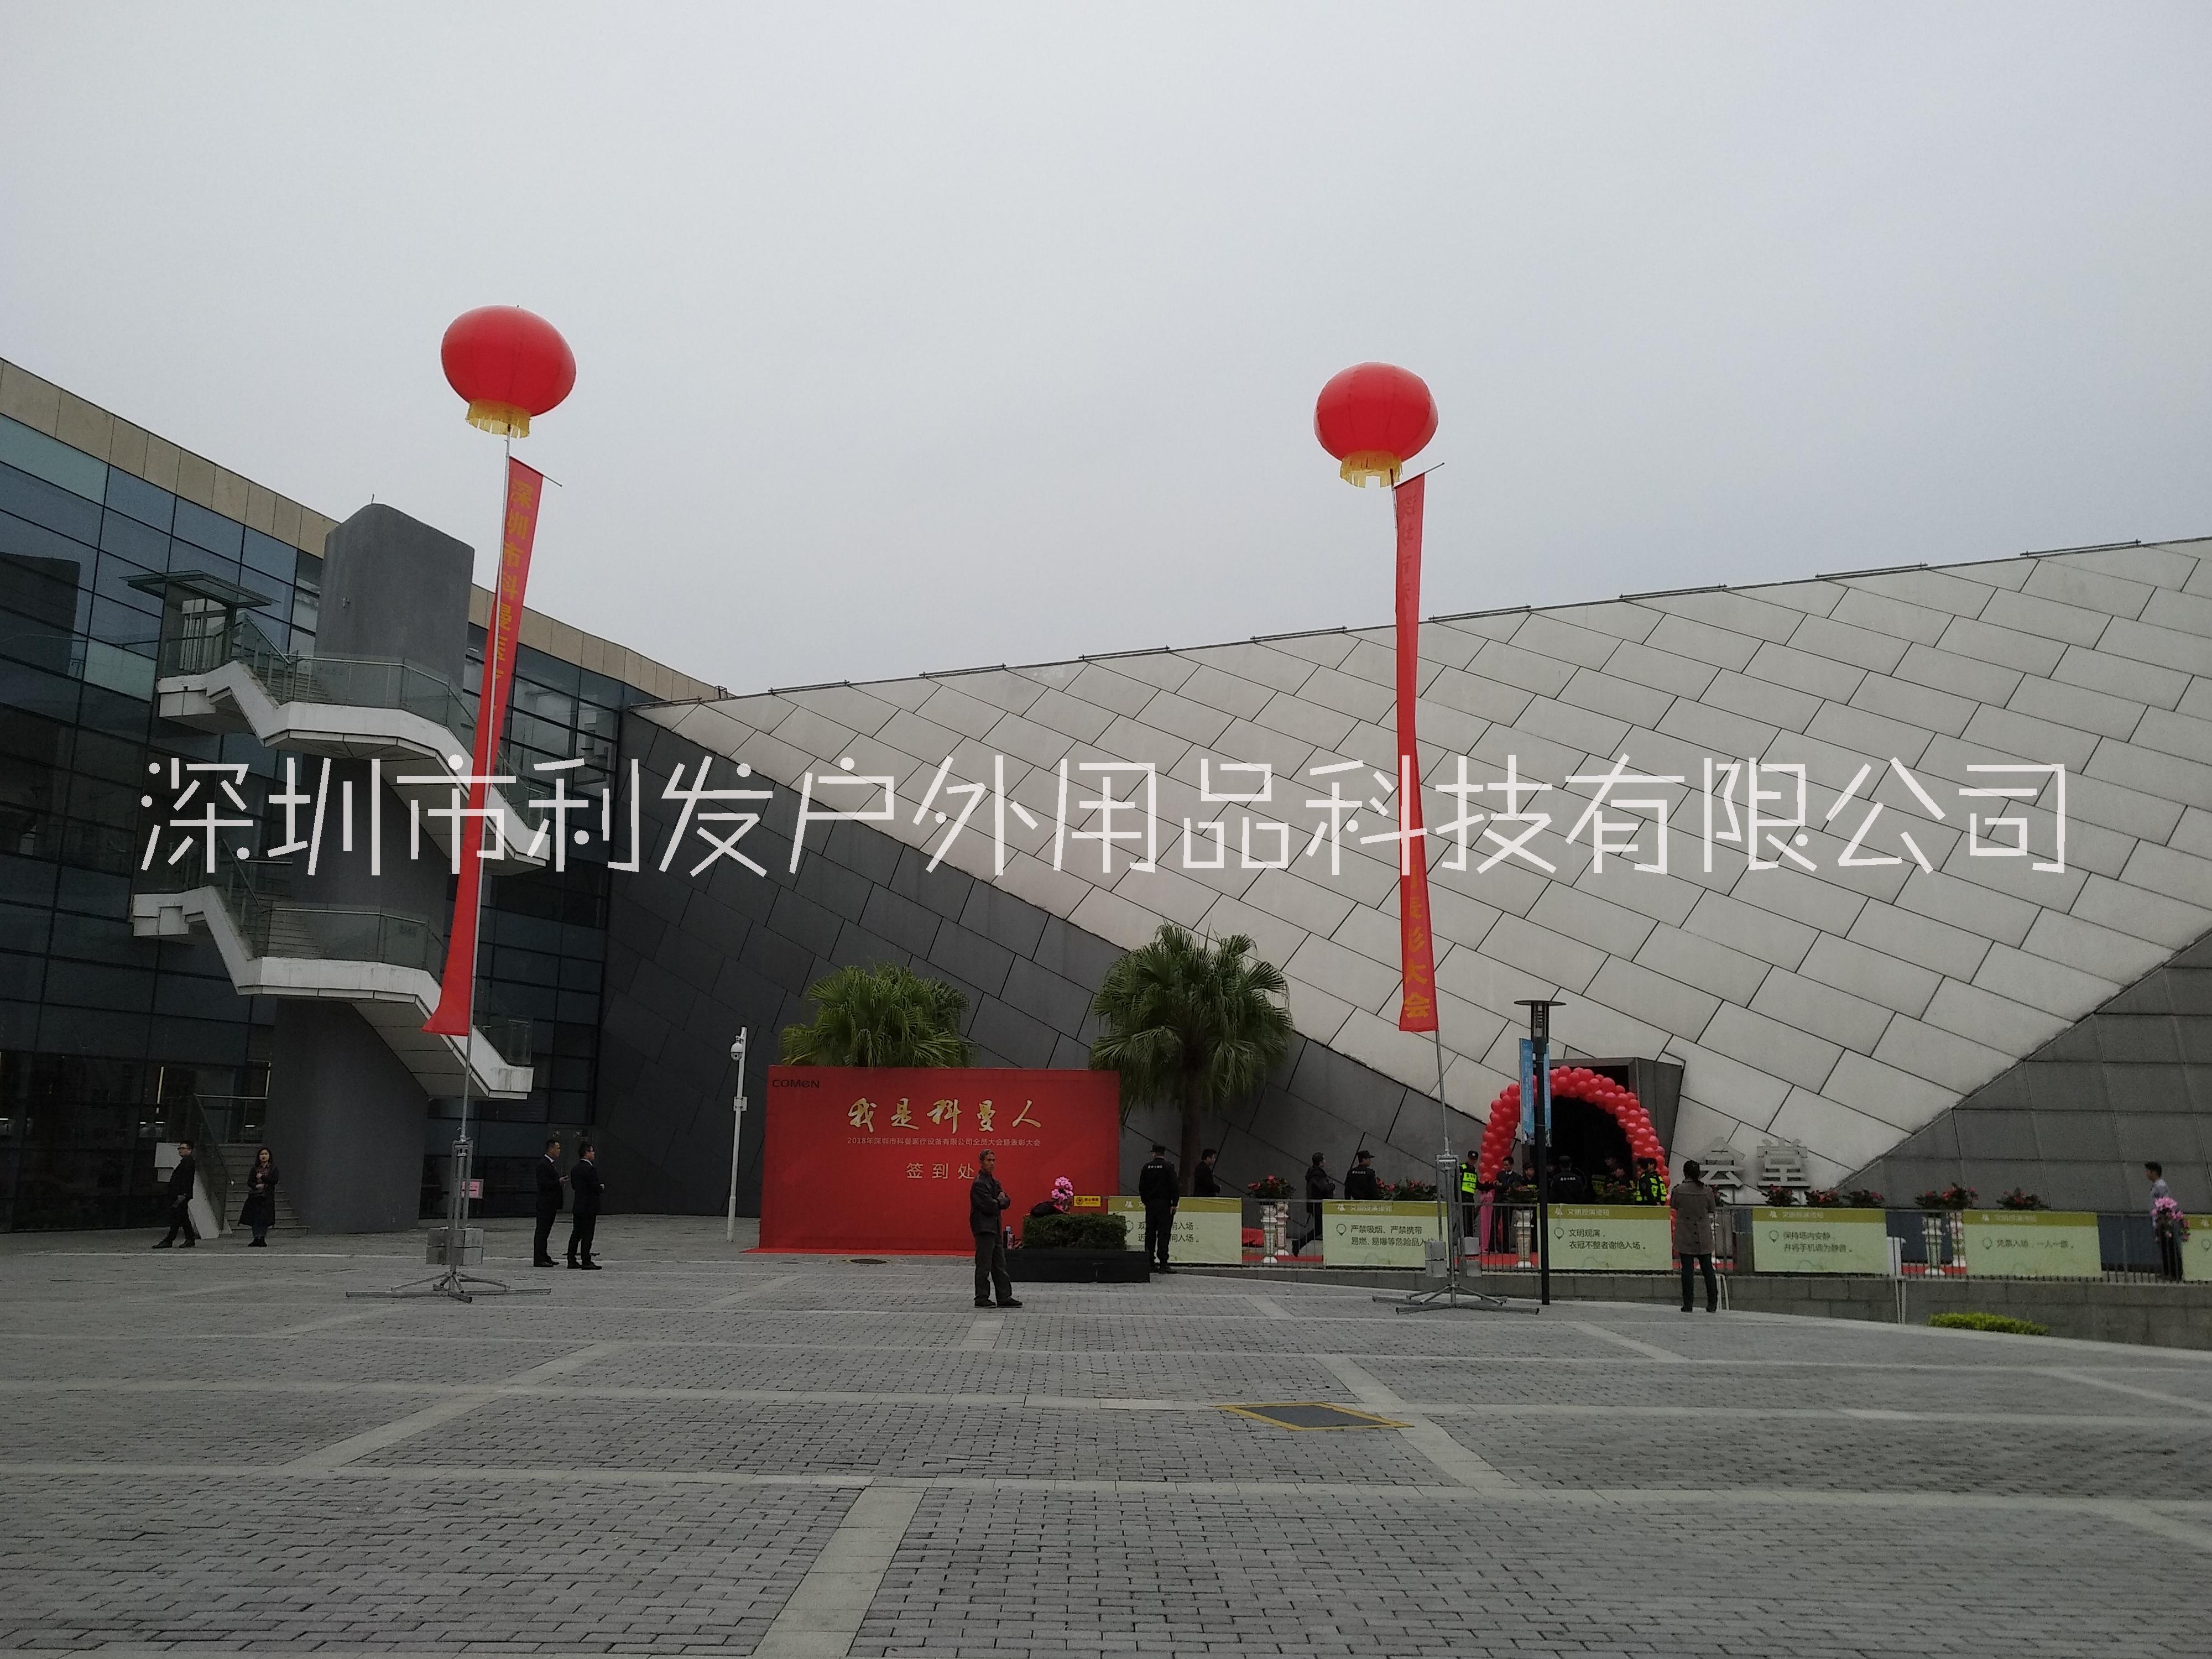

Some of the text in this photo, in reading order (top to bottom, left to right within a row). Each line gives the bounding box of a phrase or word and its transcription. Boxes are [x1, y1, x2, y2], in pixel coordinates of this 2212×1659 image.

[848, 1097, 1042, 1134] 我是科曼人
[906, 1162, 975, 1180] 签到处
[1696, 1136, 1811, 1189] 会堂
